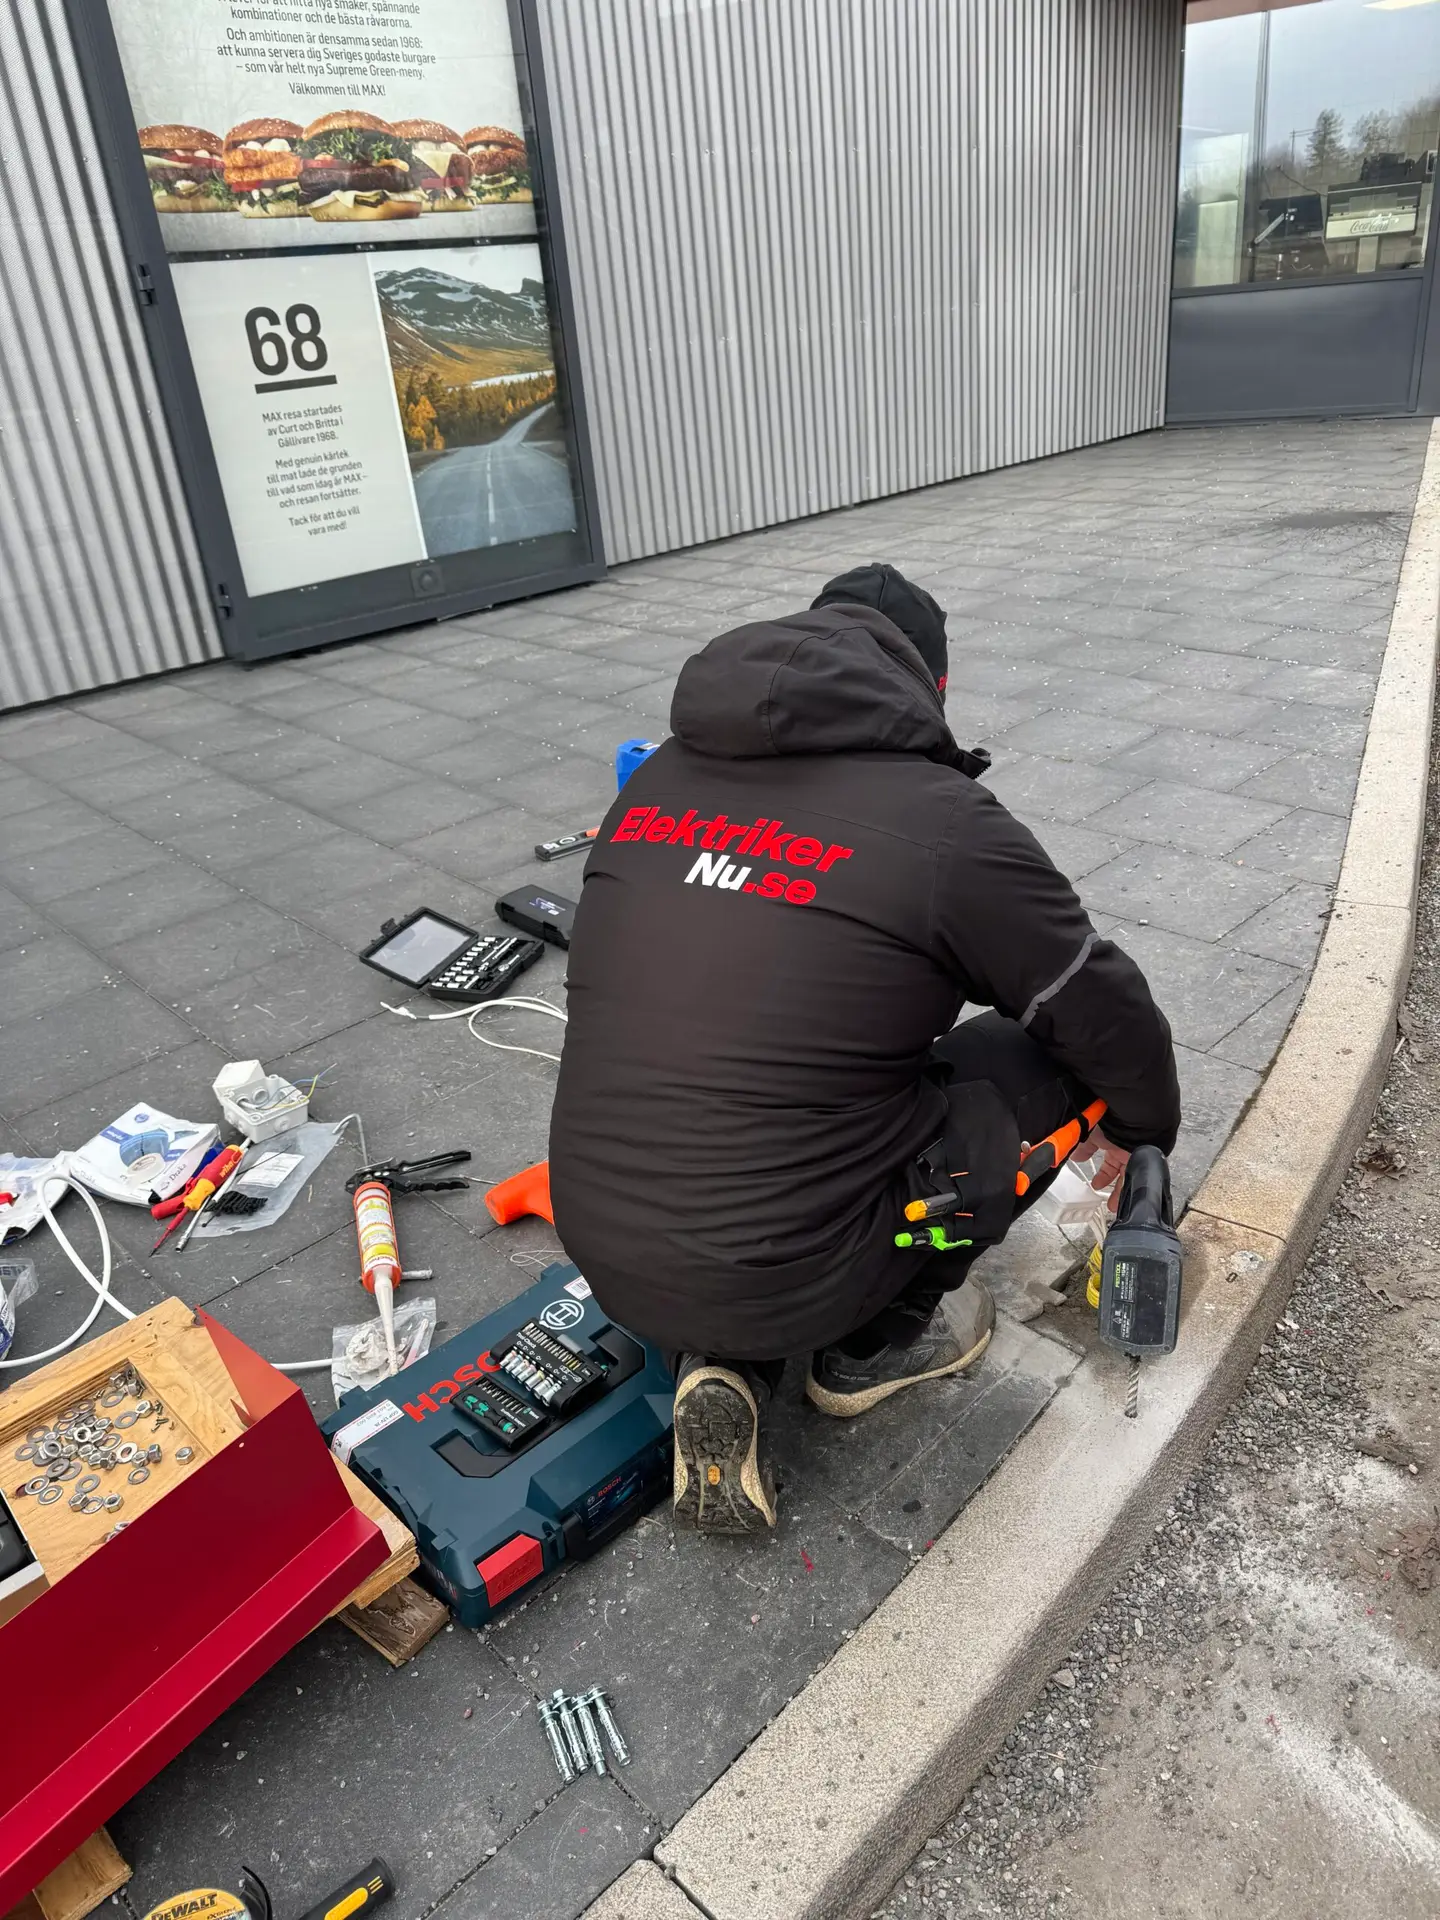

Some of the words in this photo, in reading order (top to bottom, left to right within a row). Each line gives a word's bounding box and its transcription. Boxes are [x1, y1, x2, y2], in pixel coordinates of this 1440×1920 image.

[230, 6, 302, 22] kombinationer
[305, 12, 323, 23] och
[324, 12, 336, 24] de
[337, 12, 365, 26] bästa
[366, 13, 413, 28] råvarorna.
[372, 1, 420, 14] spännande
[226, 27, 247, 41] Och
[249, 29, 305, 43] ambitionen
[306, 31, 316, 44] är
[318, 32, 370, 46] densamma
[371, 35, 399, 48] sedan
[399, 36, 423, 49] 1968:
[216, 45, 233, 56] att
[234, 44, 266, 57] kunna
[268, 48, 305, 59] servera
[306, 47, 322, 61] dig
[322, 47, 363, 63] Sveriges
[364, 50, 401, 64] godaste
[401, 51, 436, 66] burgare
[244, 62, 267, 73] som
[268, 60, 284, 73] vår
[285, 61, 306, 74] helt
[307, 65, 325, 77] nya
[326, 62, 368, 78] Supreme
[369, 64, 425, 80] Green-meny.
[288, 81, 346, 96] Välkommen
[347, 84, 361, 96] till
[361, 84, 386, 97] MAX!
[244, 303, 329, 376] 68
[262, 411, 282, 423] MAX
[283, 410, 302, 420] resa
[303, 404, 343, 418] startades
[267, 427, 278, 437] av
[278, 424, 299, 435] Curt
[299, 420, 315, 431] och
[315, 418, 340, 430] Britta
[277, 435, 316, 448] Gällivare
[275, 457, 294, 469] Med
[294, 453, 323, 468] genuin
[323, 448, 350, 461] kärlek
[266, 473, 280, 484] till
[280, 471, 298, 482] mat
[298, 468, 317, 479] lade
[317, 465, 328, 476] de
[329, 461, 363, 476] grunden
[266, 487, 280, 498] till
[280, 484, 296, 496] vad
[296, 482, 315, 493] som
[333, 476, 342, 486] är
[343, 472, 362, 484] MAX
[279, 498, 296, 509] och
[295, 494, 320, 505] resan
[288, 515, 310, 527] Tack
[309, 512, 322, 523] för
[322, 510, 336, 520] att
[336, 507, 347, 518] du
[347, 505, 360, 516] vill
[308, 526, 326, 536] vara
[610, 806, 854, 872] Elektriker
[684, 852, 817, 905] Nu.se
[402, 1350, 501, 1423] OSCH
[597, 1475, 622, 1497] BOSCH
